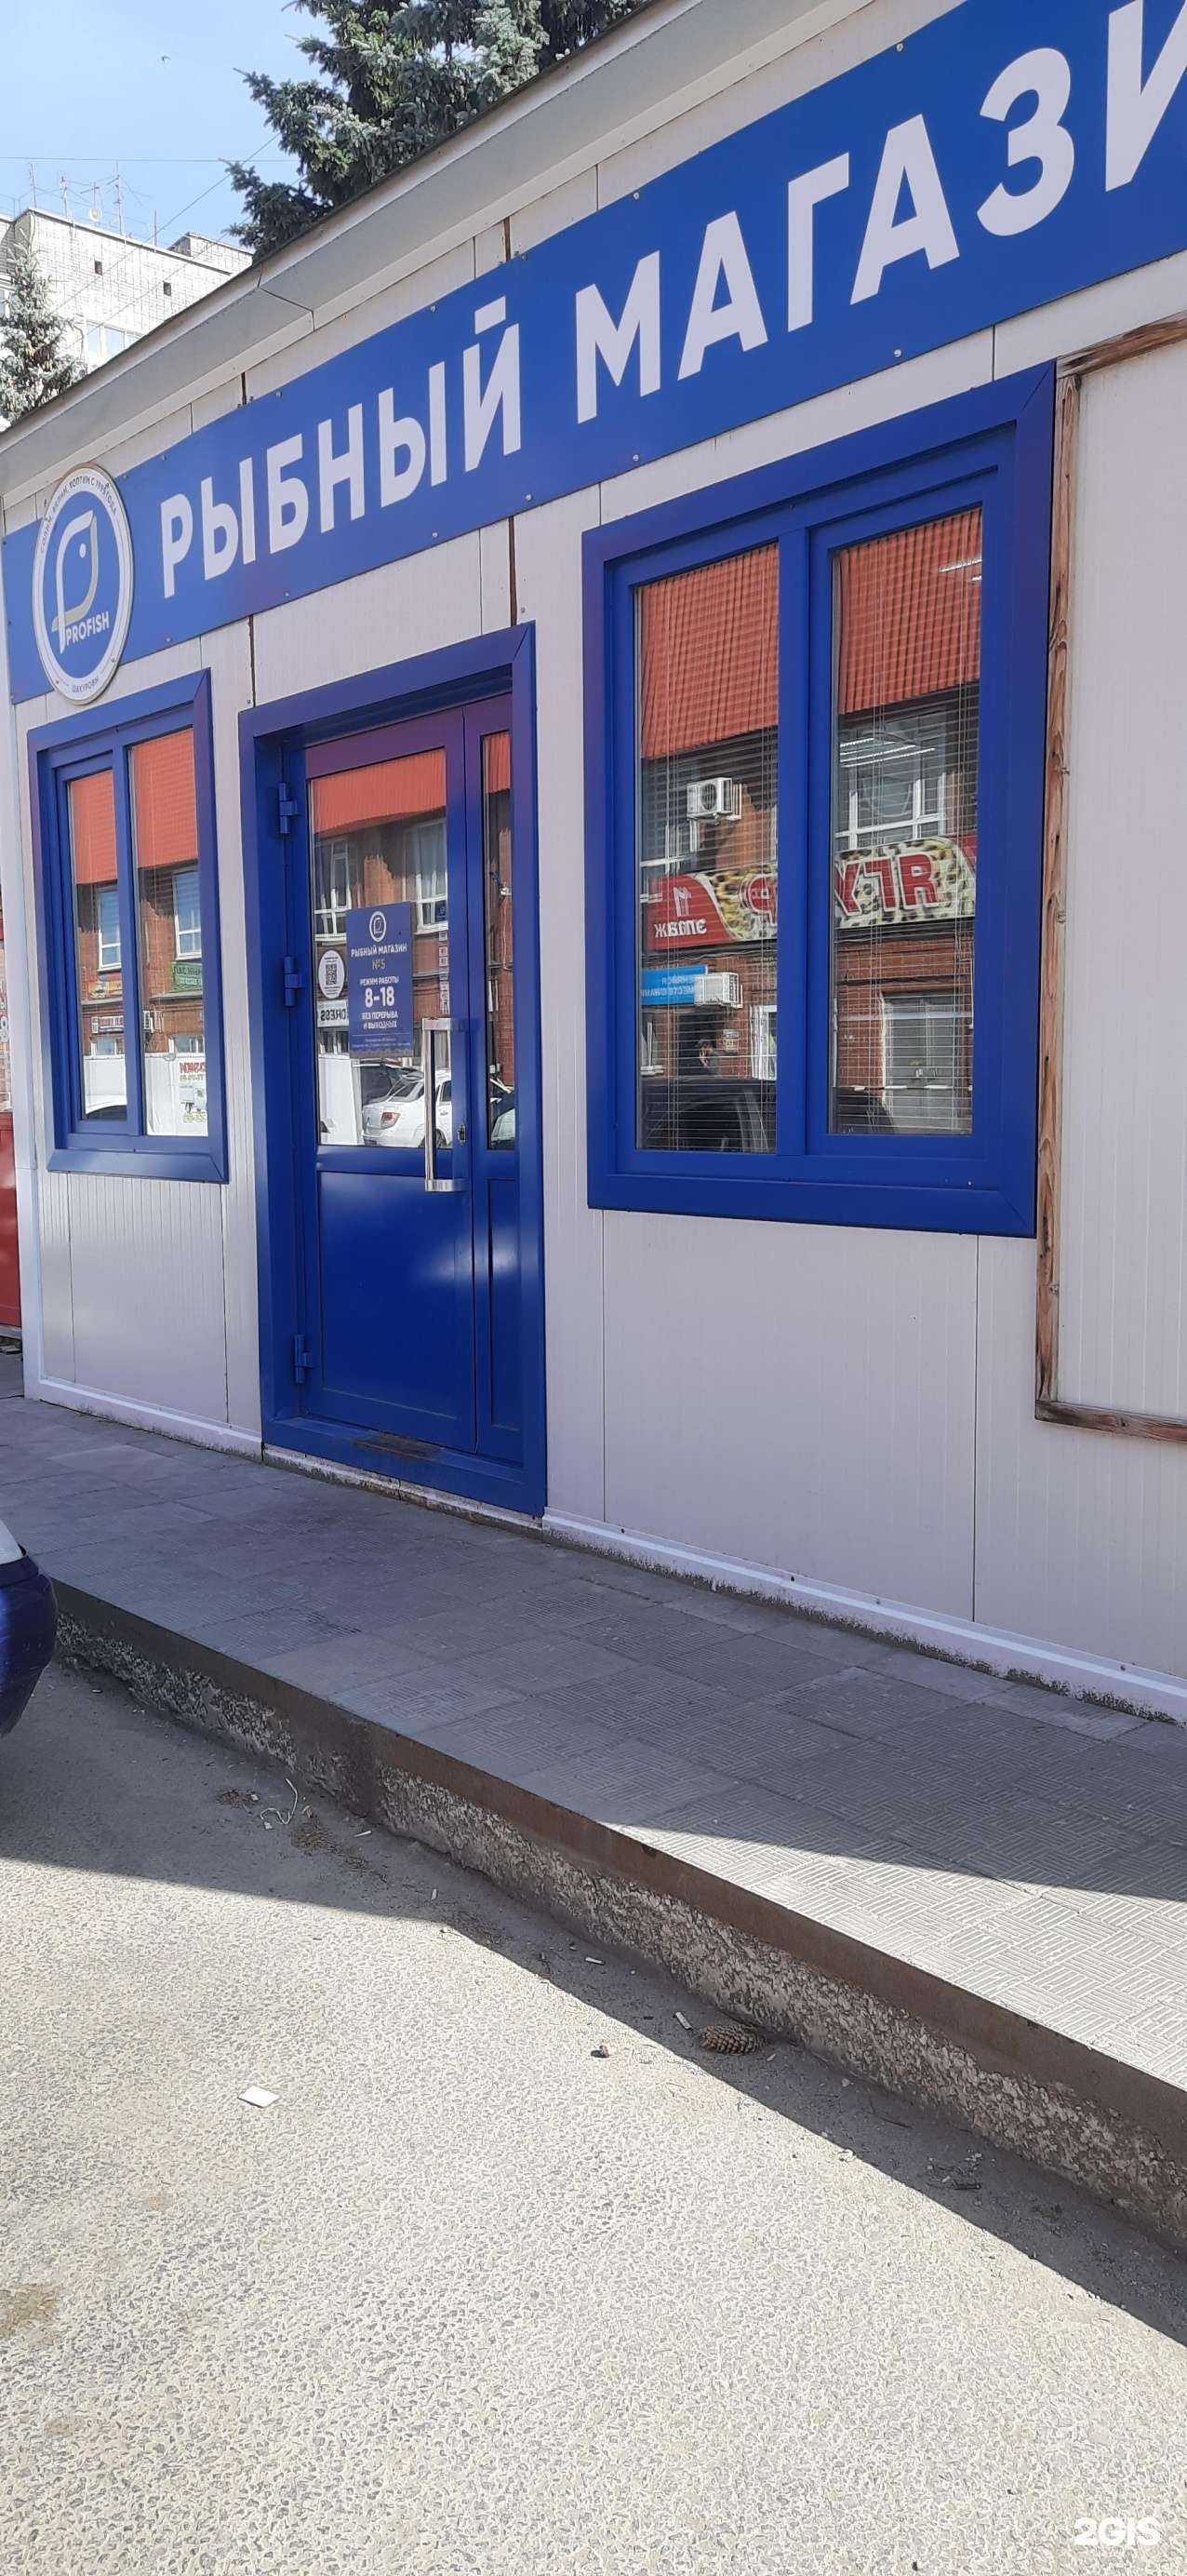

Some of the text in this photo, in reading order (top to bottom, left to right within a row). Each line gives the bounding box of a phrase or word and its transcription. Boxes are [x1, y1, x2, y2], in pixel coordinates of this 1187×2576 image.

[160, 296, 521, 599] РЫБНЫЙ
[65, 610, 110, 647] PROFISH
[351, 942, 407, 958] РЫБНЫЙ МАГАЗИН
[359, 975, 399, 986] РЕЖИМ РАБОТЫ
[364, 986, 395, 1008] 8-18
[361, 1010, 398, 1020] БЕЗ ПЕРЕРЫВА
[367, 1020, 397, 1030] ВЫХОДНЫХ
